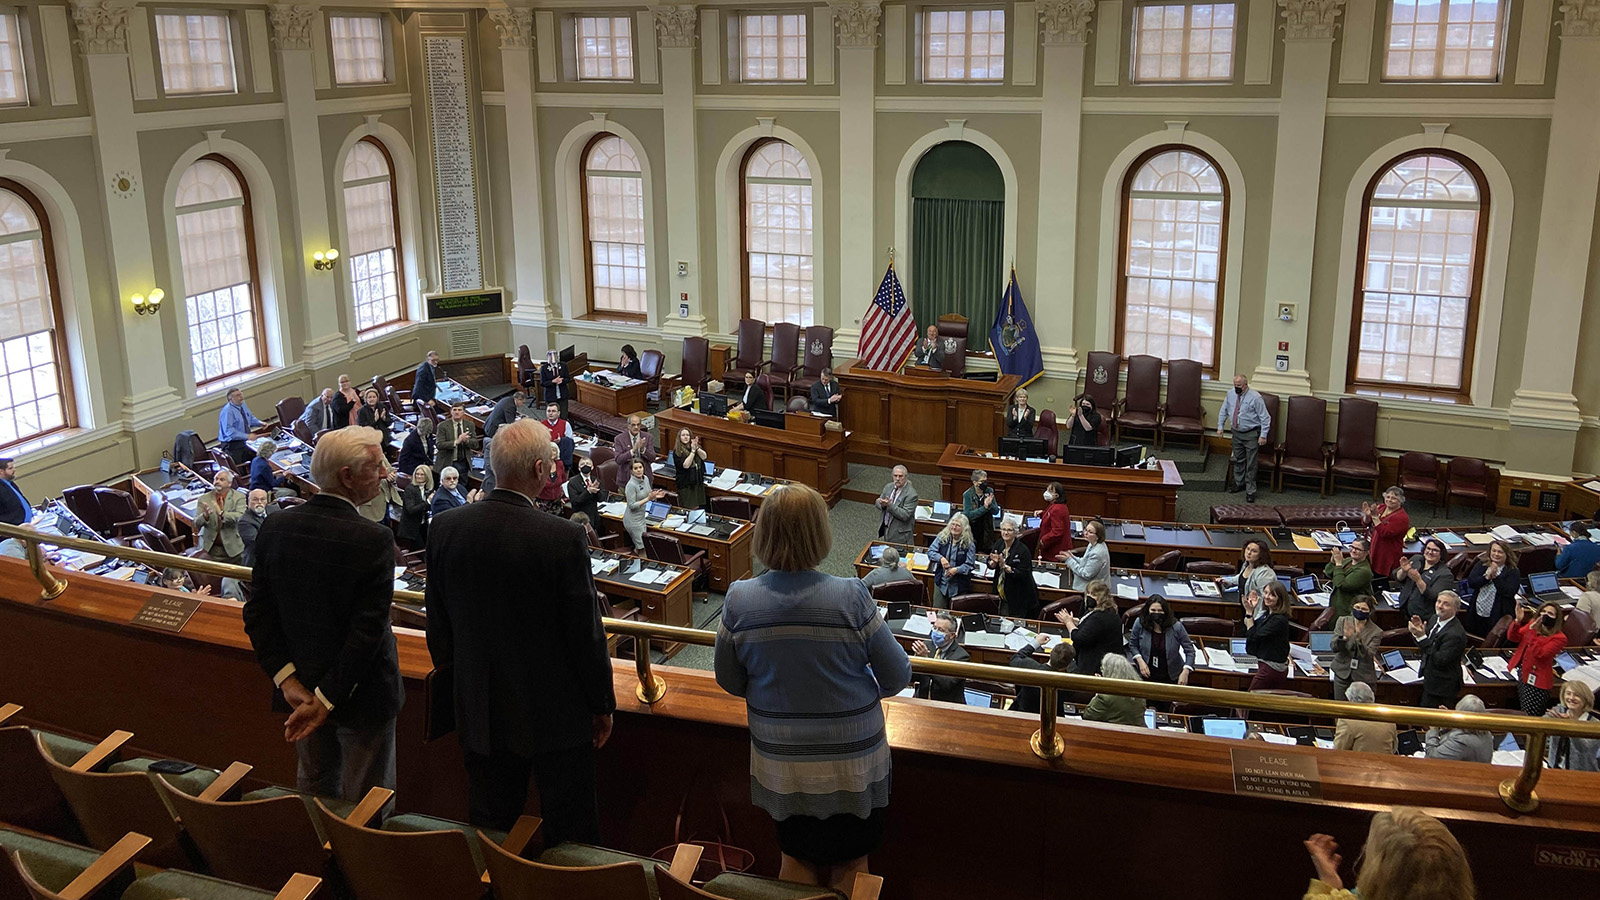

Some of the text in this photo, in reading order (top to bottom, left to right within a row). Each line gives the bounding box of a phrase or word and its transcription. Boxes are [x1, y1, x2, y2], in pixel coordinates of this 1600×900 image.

[162, 599, 183, 607] PLEASE
[1260, 756, 1288, 766] PLEASE
[1570, 850, 1586, 858] NO
